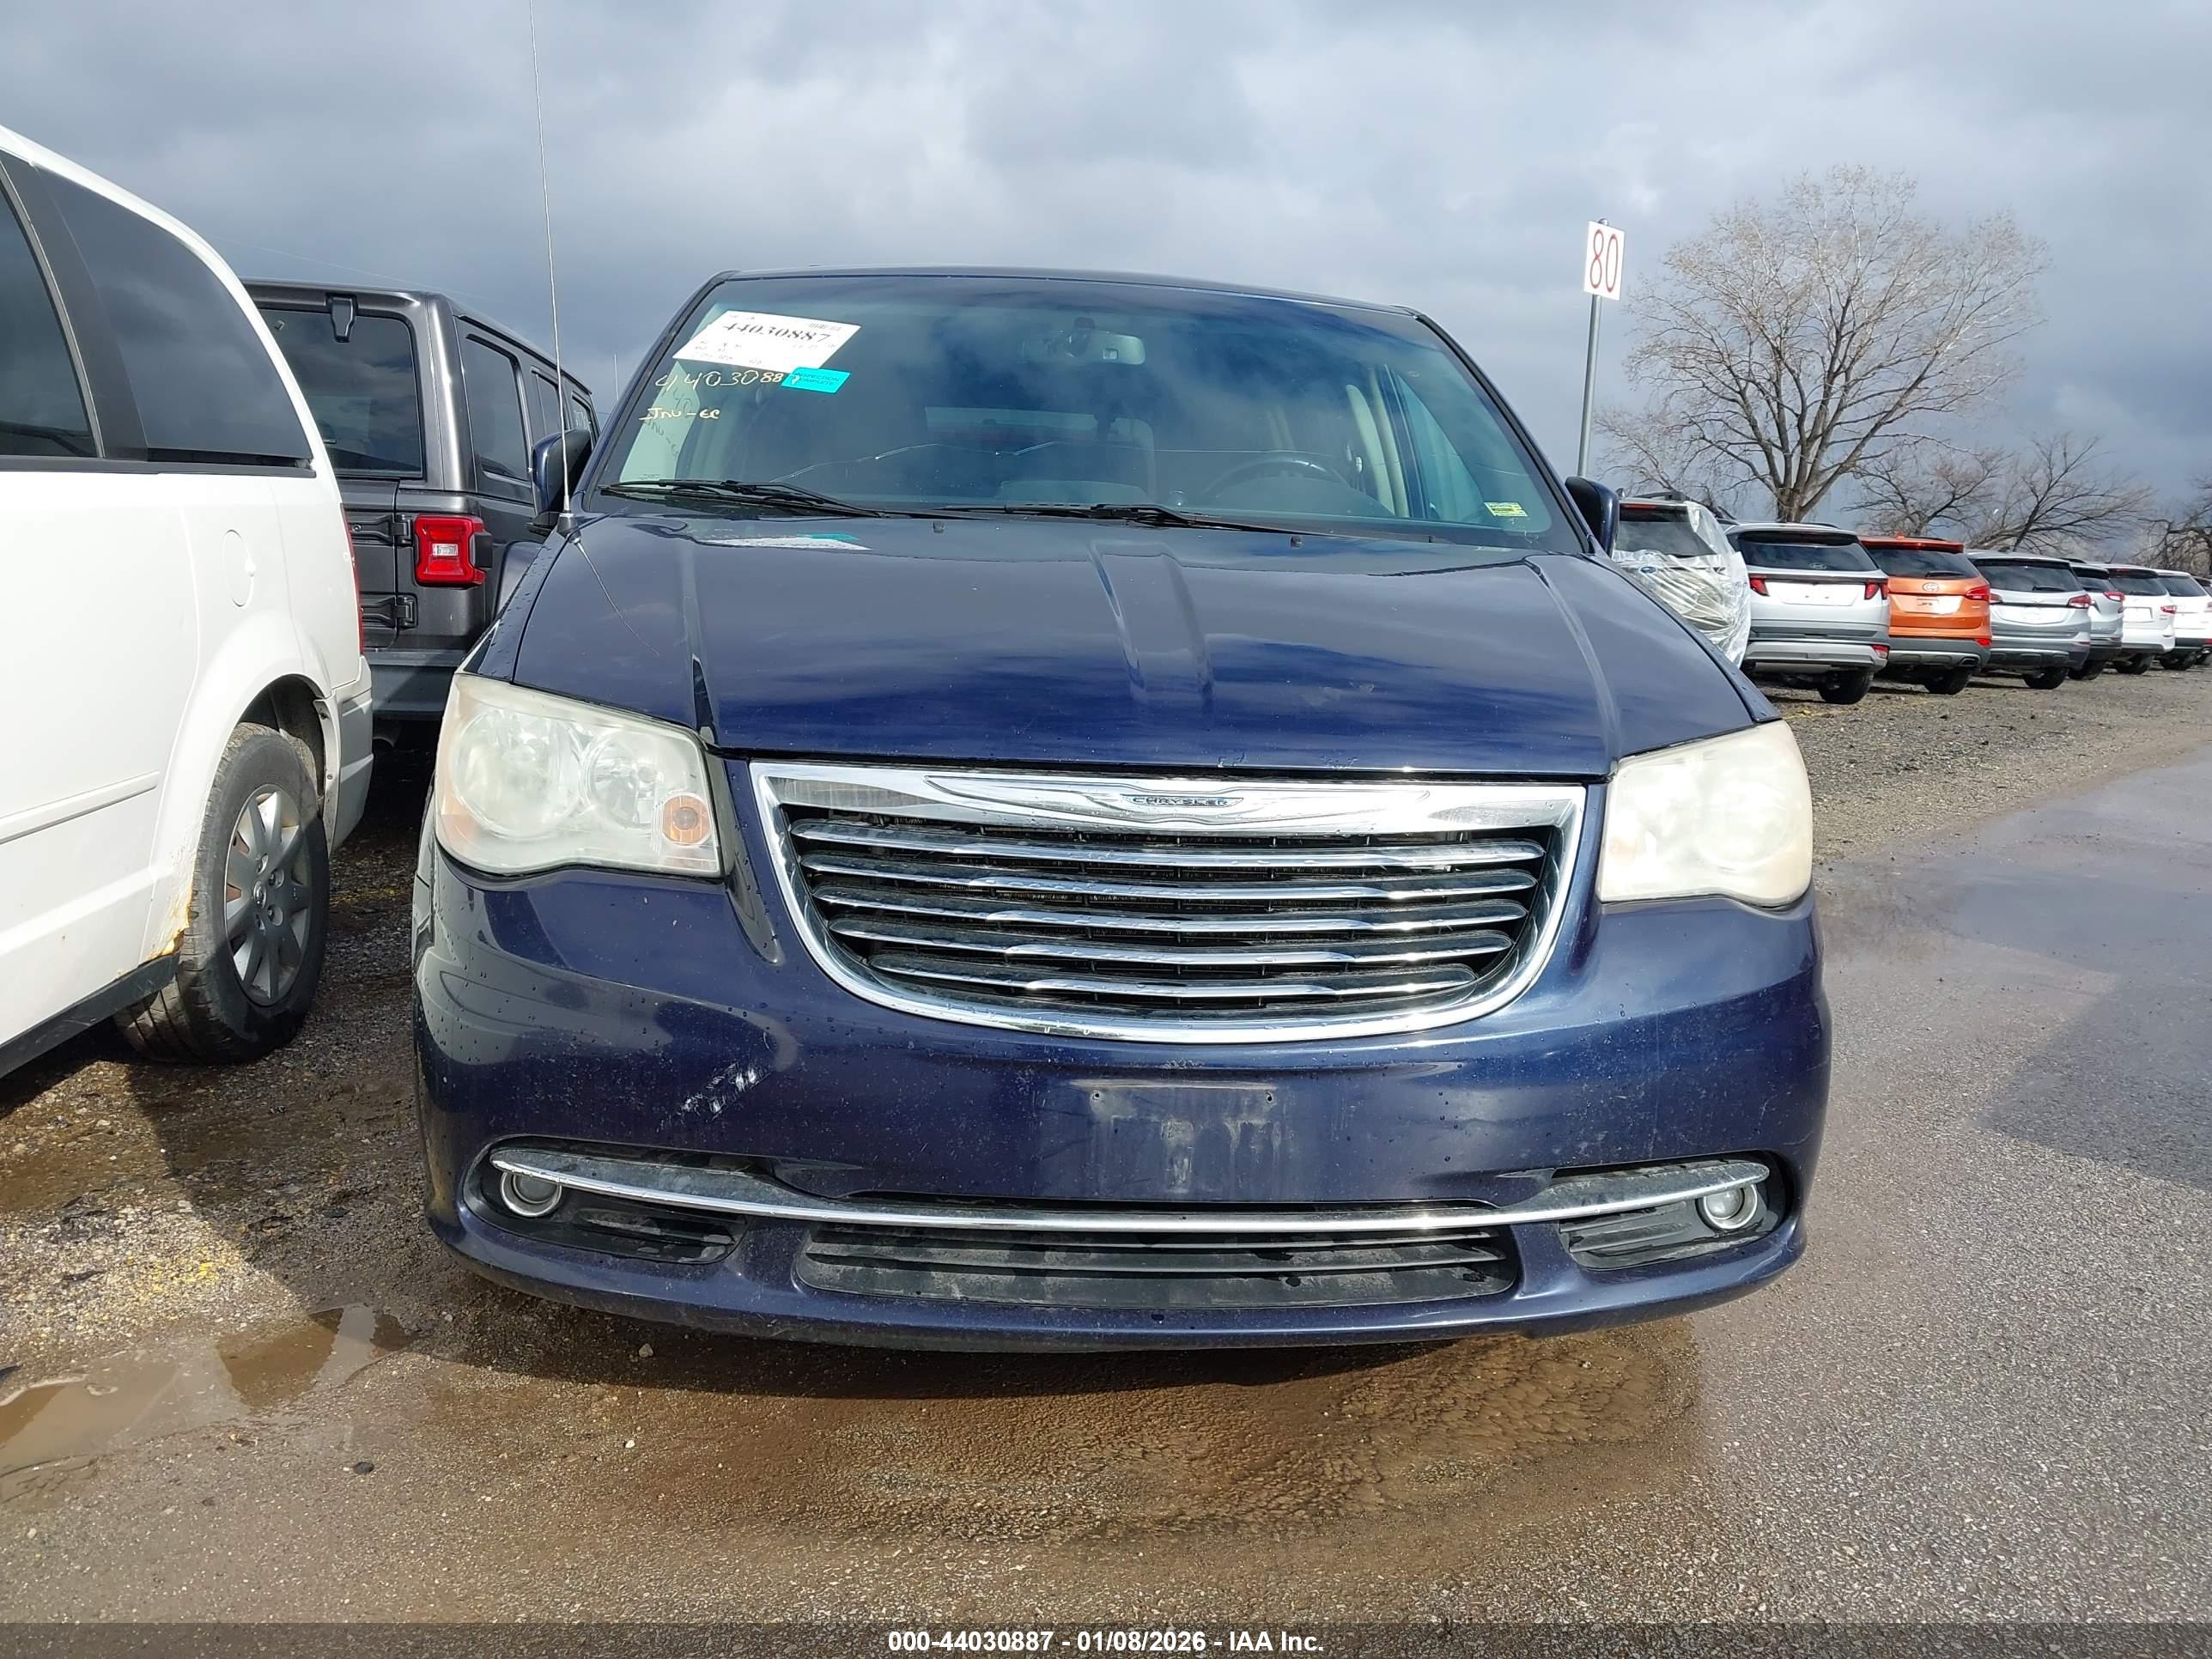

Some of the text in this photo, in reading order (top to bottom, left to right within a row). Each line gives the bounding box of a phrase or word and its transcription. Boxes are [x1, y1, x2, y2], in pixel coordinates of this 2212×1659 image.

[1589, 228, 1619, 293] 80
[723, 322, 831, 343] 44030887
[1133, 796, 1228, 805] CHRYSLER
